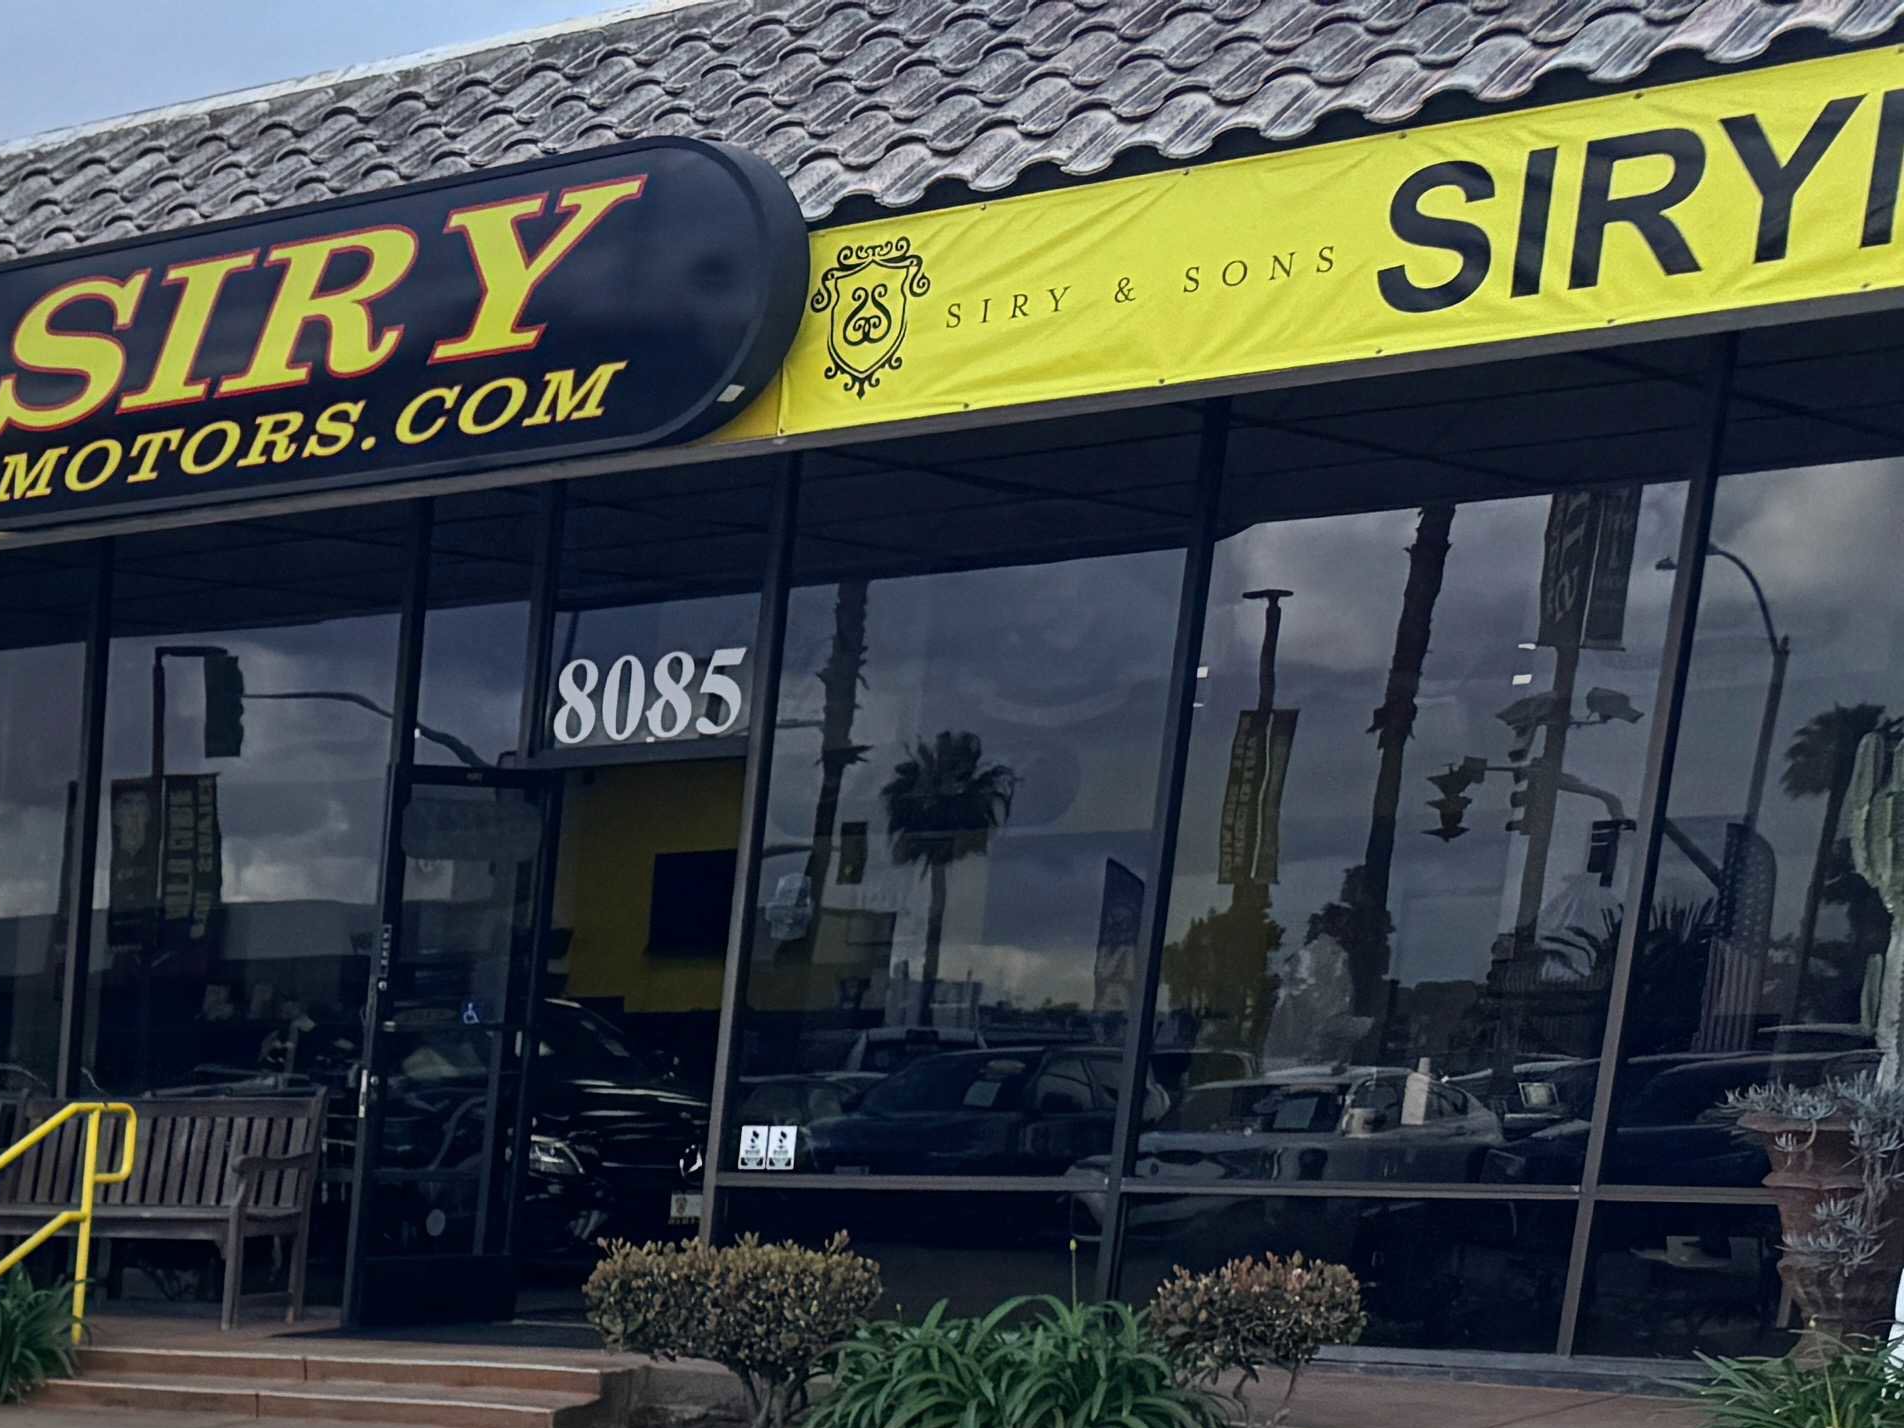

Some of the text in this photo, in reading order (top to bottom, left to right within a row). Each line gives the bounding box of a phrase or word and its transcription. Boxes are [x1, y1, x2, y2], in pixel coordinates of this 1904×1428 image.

[946, 245, 1338, 330] SIRY & SONS
[553, 647, 748, 745] 8085
